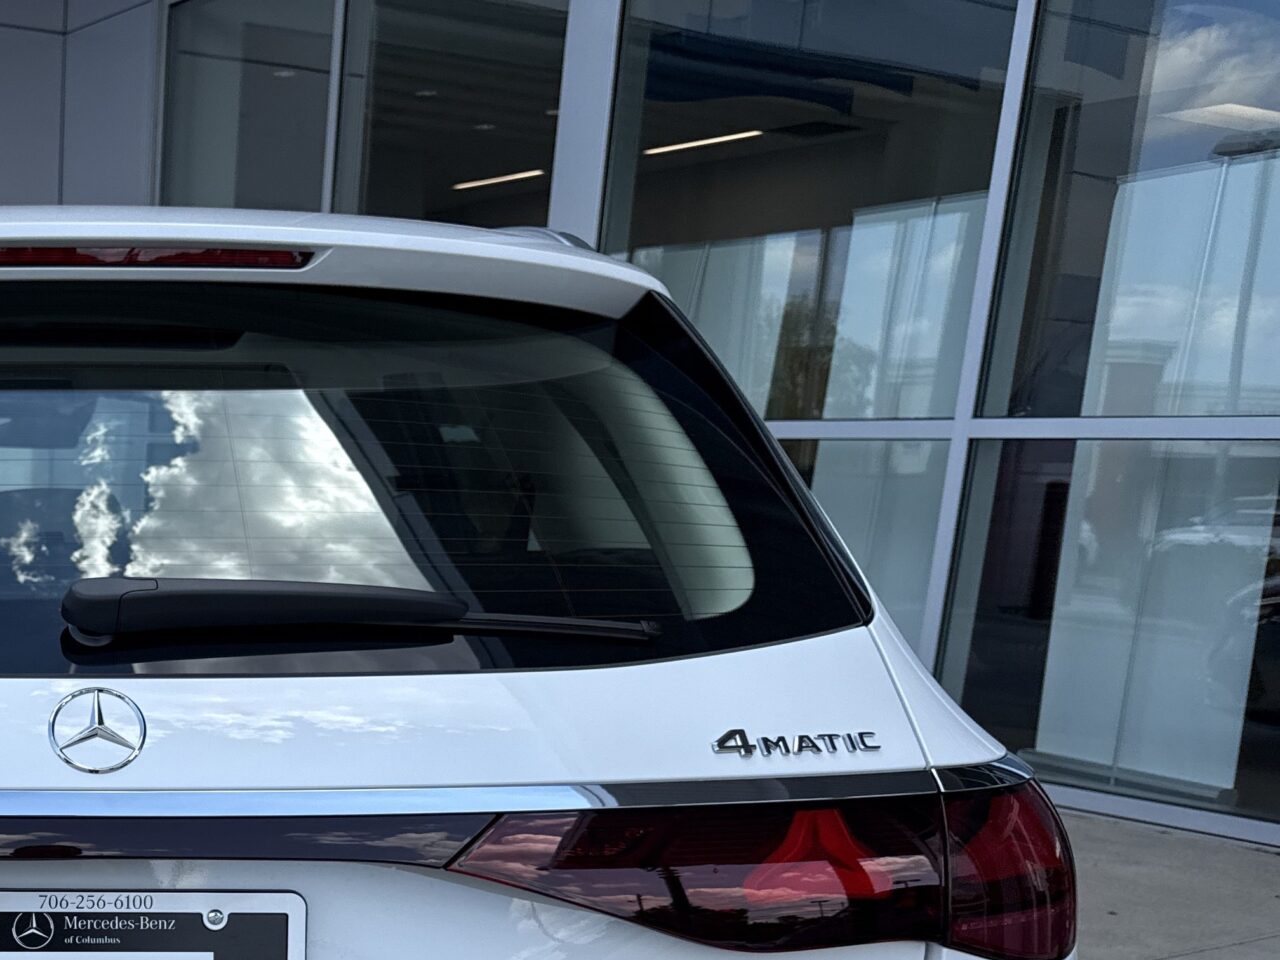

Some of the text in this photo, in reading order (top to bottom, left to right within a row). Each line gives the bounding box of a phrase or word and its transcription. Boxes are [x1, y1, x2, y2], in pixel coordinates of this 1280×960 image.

[711, 729, 882, 757] 4MATIC
[38, 894, 154, 910] 706-256-6100
[64, 915, 176, 930] Mercedes-Benz
[64, 935, 121, 944] of Columbus
